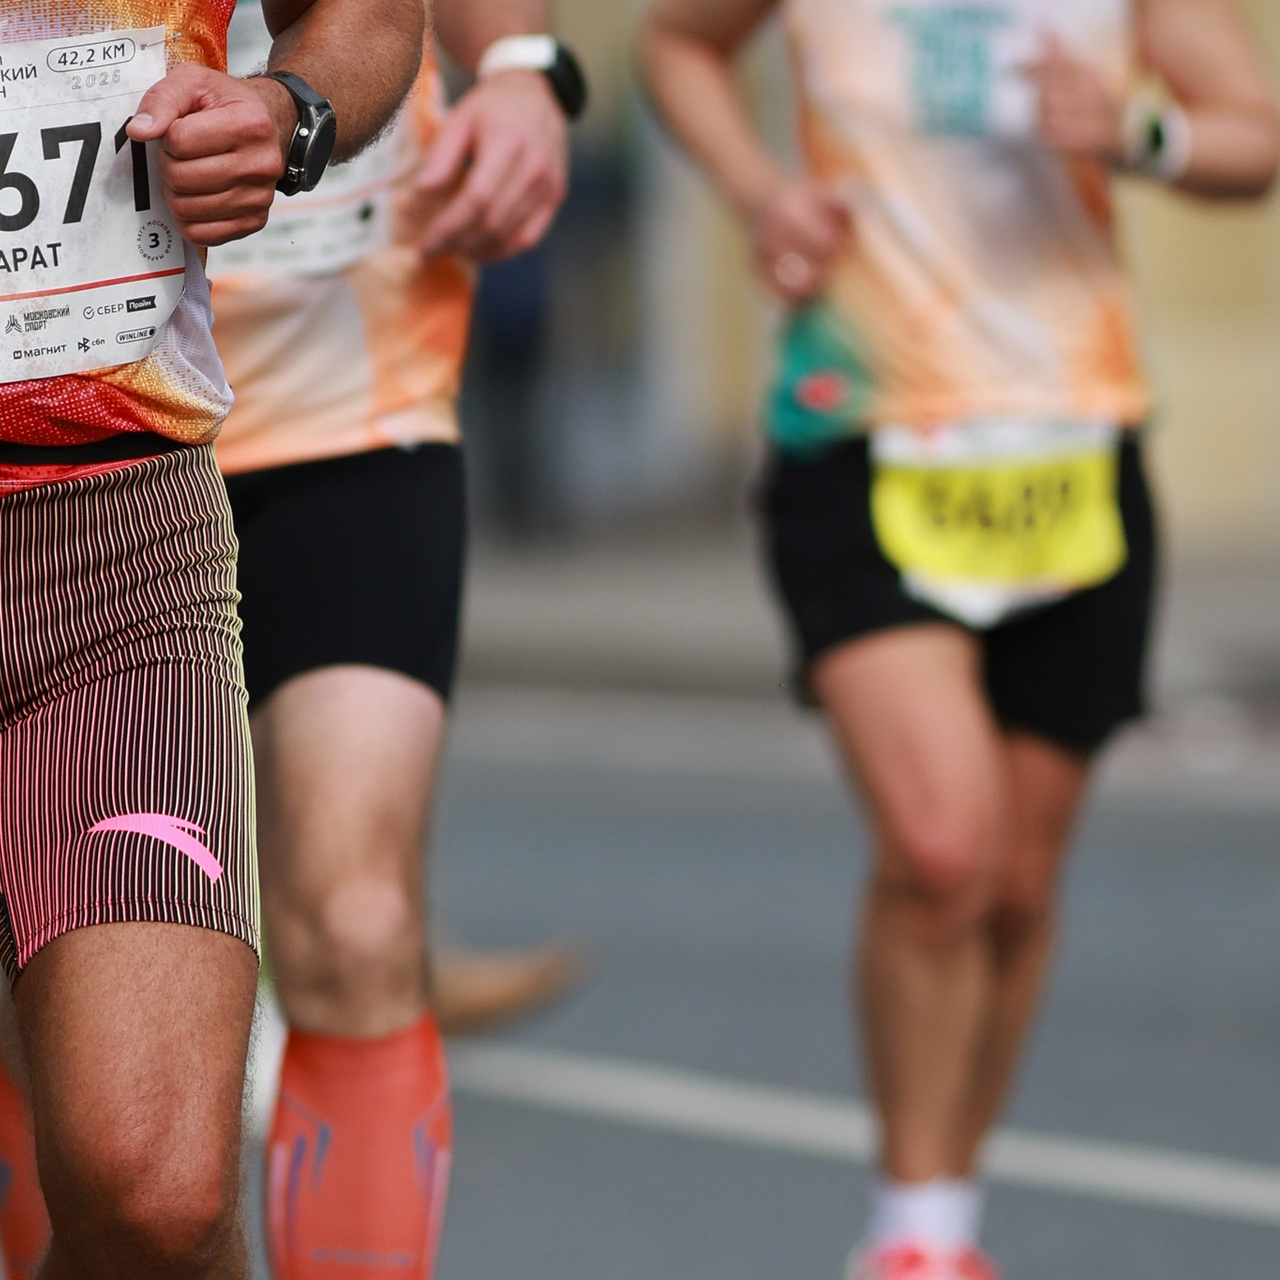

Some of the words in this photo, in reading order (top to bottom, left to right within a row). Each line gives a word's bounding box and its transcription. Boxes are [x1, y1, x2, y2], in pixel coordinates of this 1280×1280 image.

[57, 48, 96, 67] 42,2
[148, 232, 160, 249] 3
[23, 305, 70, 321] МОСКОВСКИЙ
[97, 303, 124, 316] СБЕР
[128, 300, 152, 310] Прайм
[24, 320, 47, 332] СПОРТ
[91, 338, 106, 346] сбп
[119, 330, 148, 342] WINLINE
[23, 344, 67, 358] магнит
